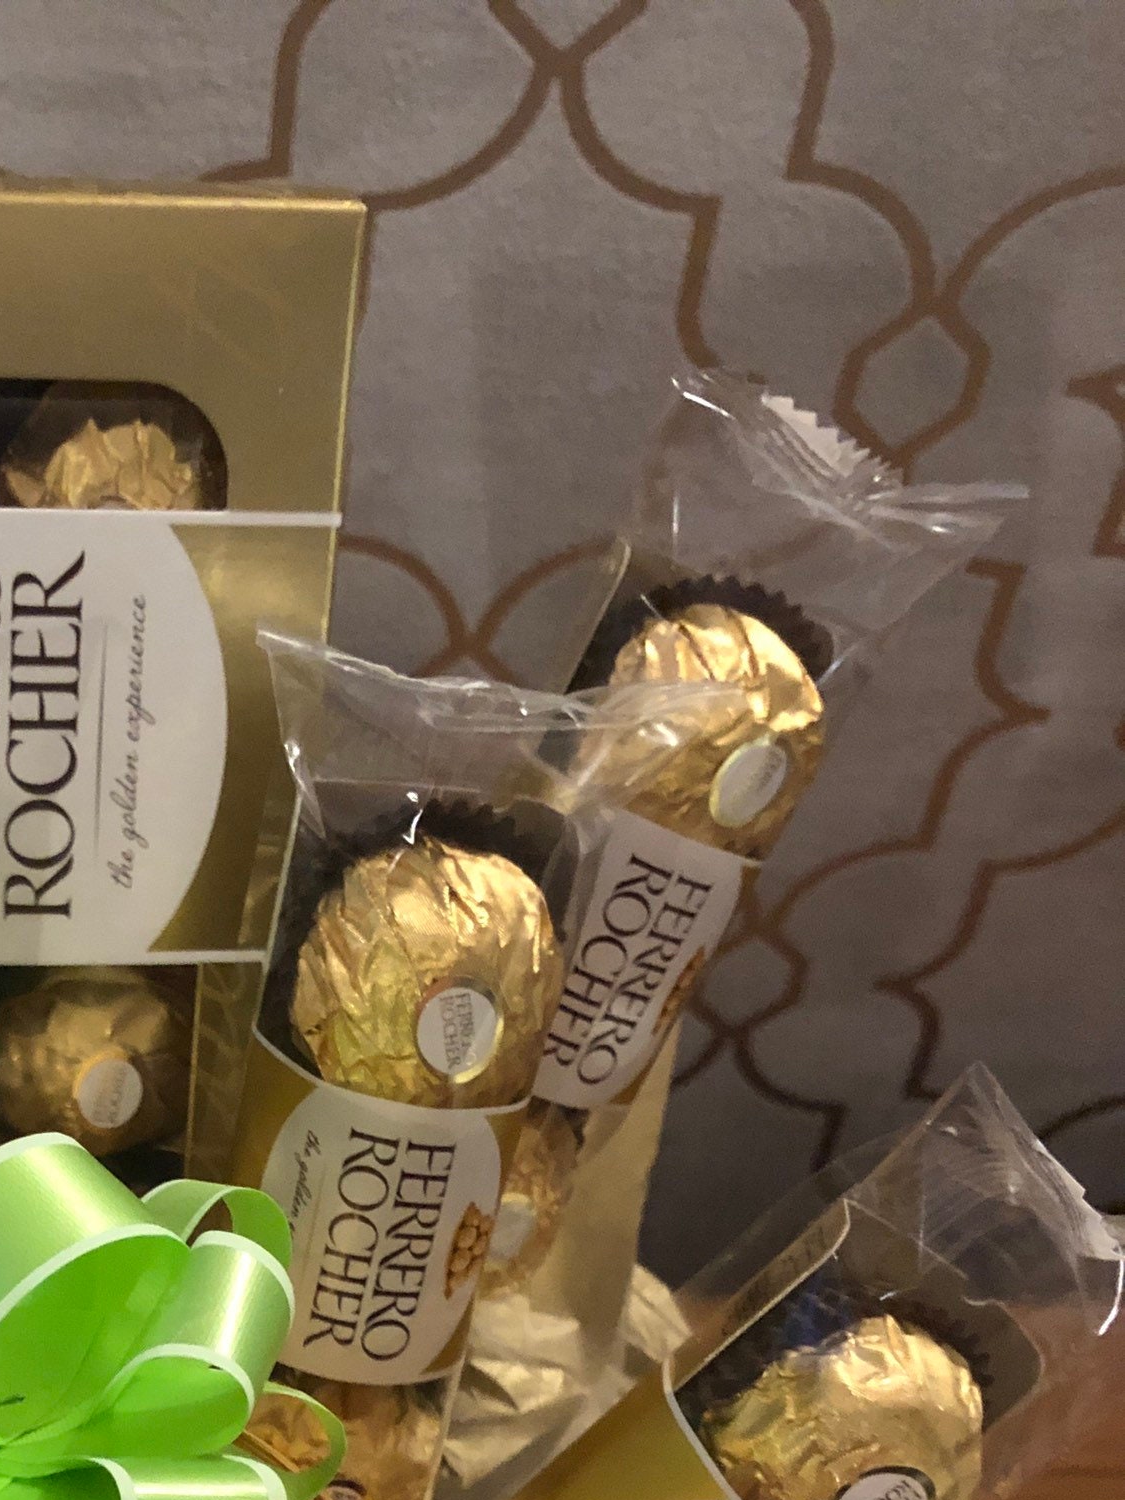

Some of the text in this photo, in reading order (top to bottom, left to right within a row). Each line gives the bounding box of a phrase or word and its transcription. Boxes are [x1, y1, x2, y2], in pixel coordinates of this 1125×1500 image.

[3, 550, 86, 920] ROCHER
[106, 594, 156, 889] the golden experience
[543, 853, 673, 1067] ROCHER
[576, 875, 714, 1085] FERRERO
[303, 1126, 400, 1348] ROCHER
[360, 1137, 457, 1362] FERRERO
